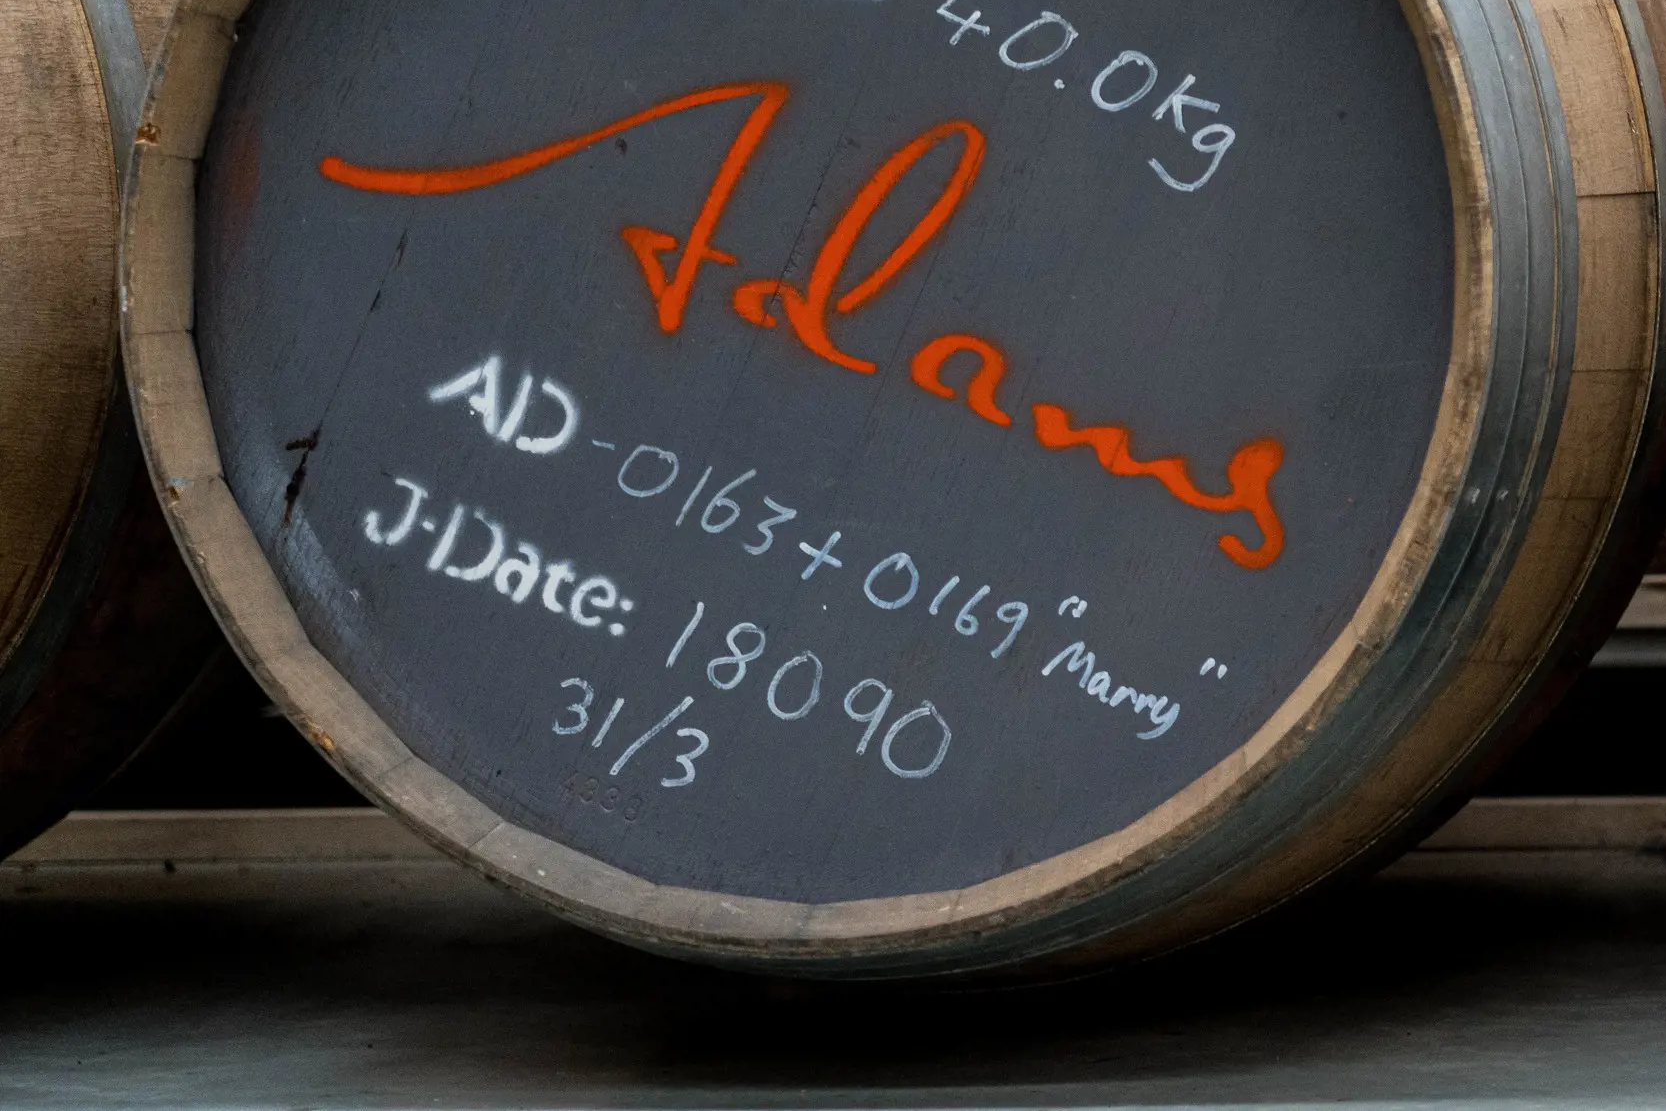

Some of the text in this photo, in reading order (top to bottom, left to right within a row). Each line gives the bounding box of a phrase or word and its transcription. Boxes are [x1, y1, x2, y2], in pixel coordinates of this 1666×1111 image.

[863, 551, 1029, 658] 0169
[551, 675, 711, 789] 31/3
[665, 600, 953, 780] 18090
